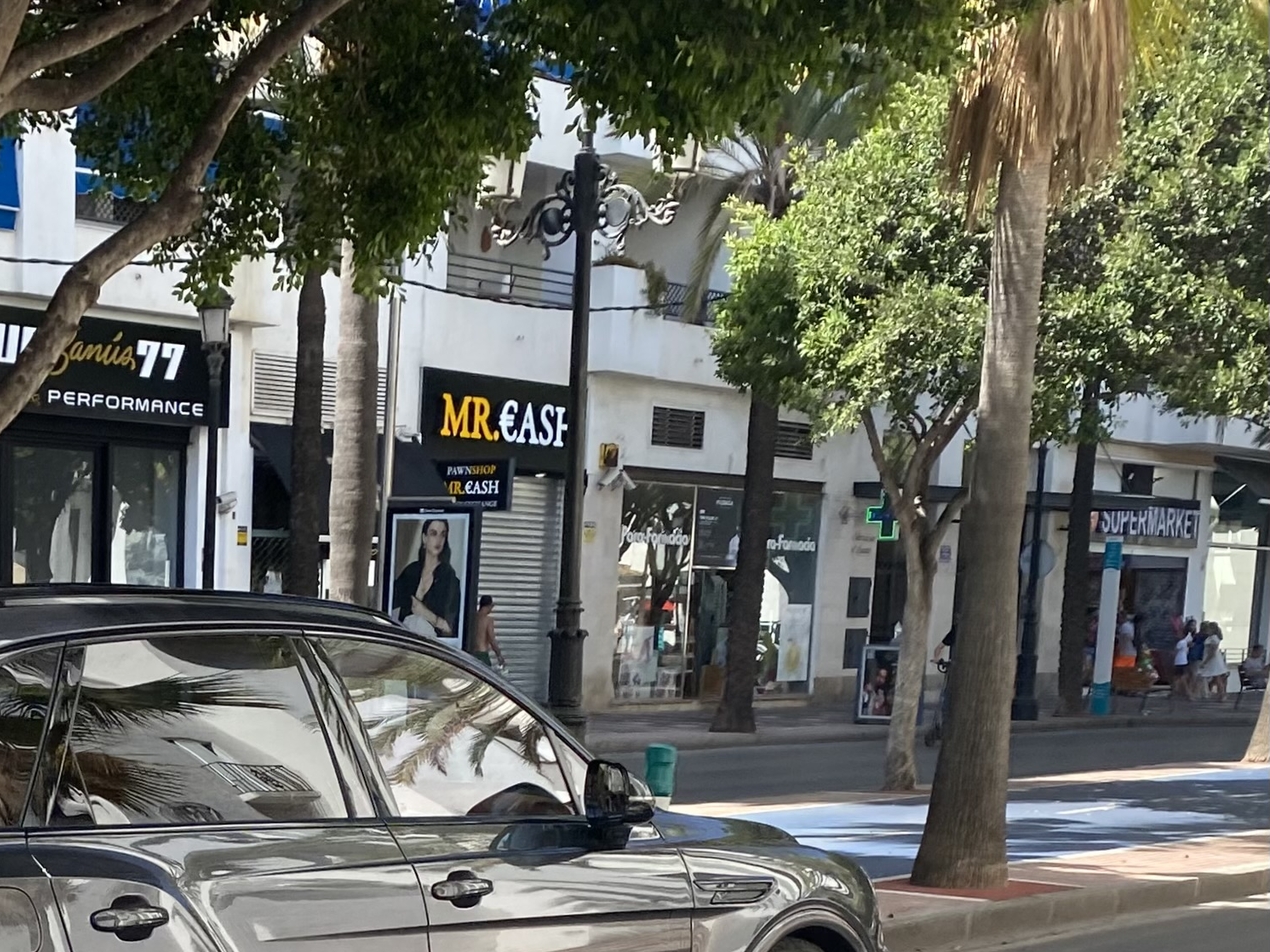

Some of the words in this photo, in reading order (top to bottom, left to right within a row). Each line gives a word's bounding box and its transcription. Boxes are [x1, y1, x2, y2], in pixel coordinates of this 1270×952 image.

[137, 339, 186, 381] 77
[47, 389, 204, 417] PERFORMANCE
[446, 464, 497, 476] PAWNSHOP
[1101, 506, 1201, 539] SUPERMARKET
[766, 533, 815, 552] ra-Farmacia
